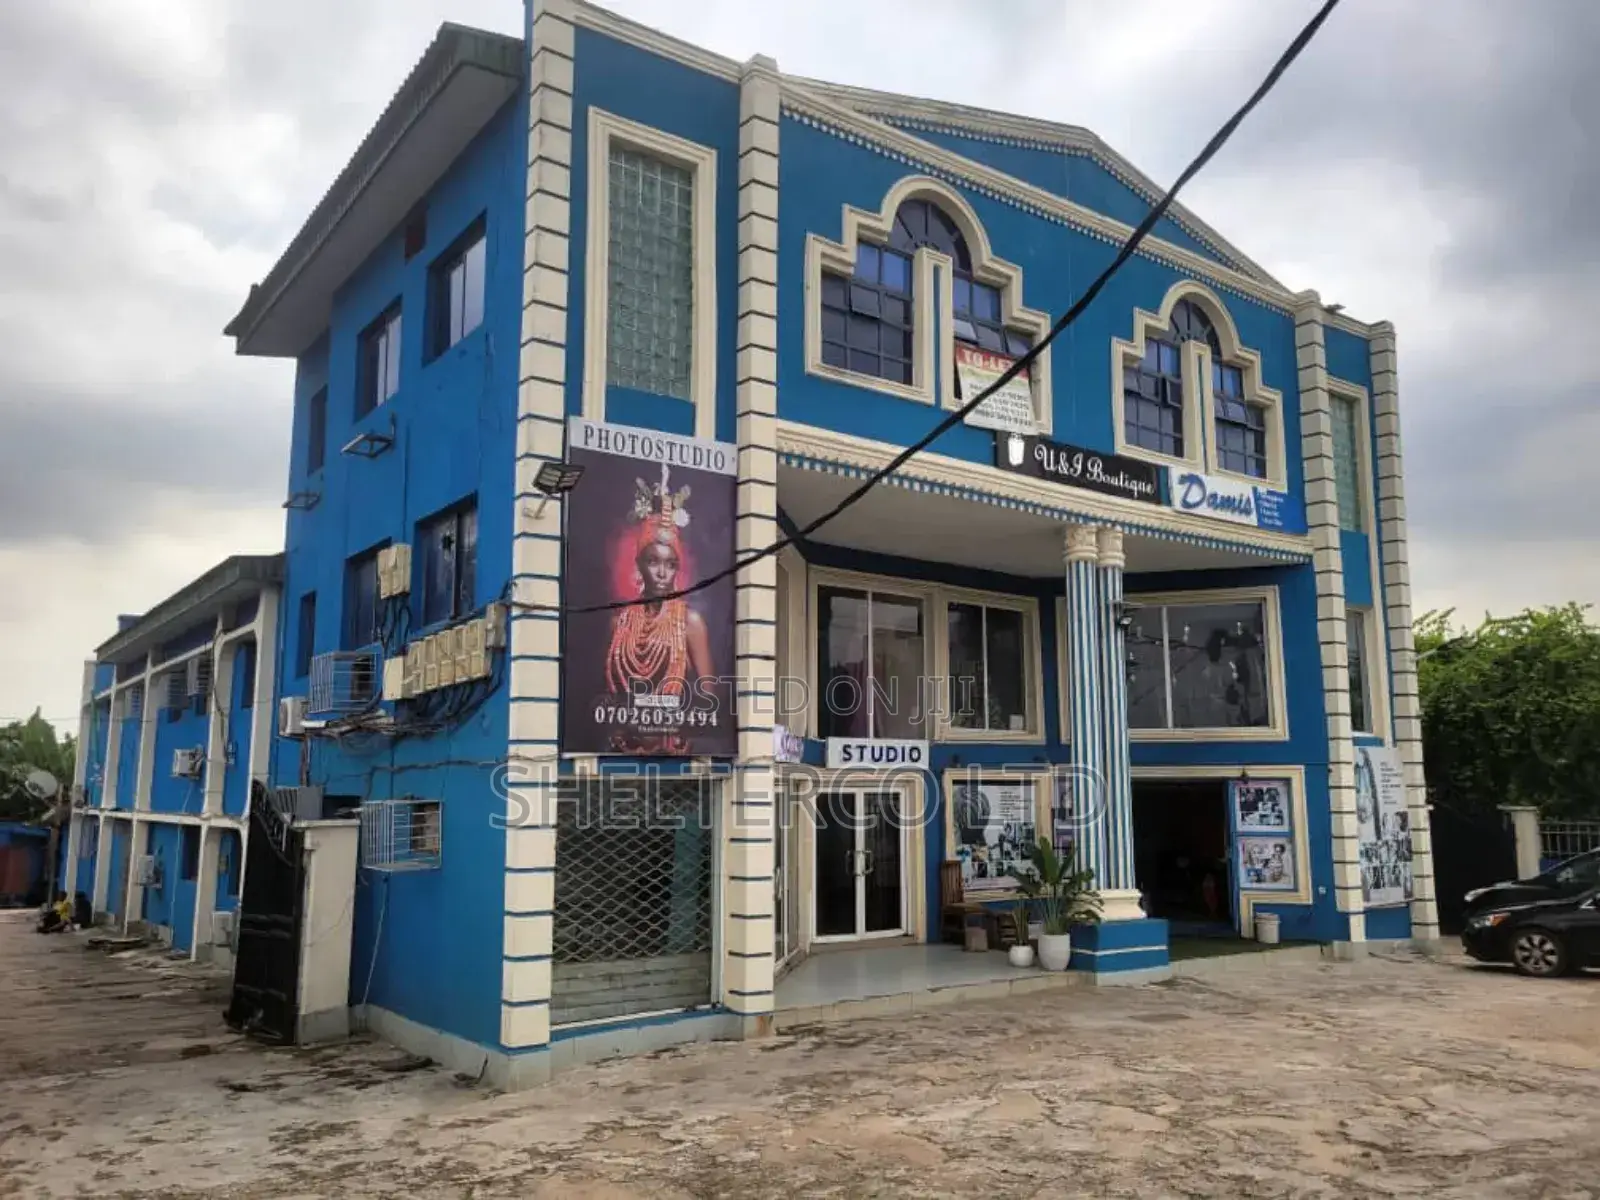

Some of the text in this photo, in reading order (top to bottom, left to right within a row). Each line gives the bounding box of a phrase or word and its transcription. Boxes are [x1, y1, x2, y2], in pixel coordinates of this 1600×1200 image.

[583, 425, 726, 471] PHOTOSTUDIO
[1086, 456, 1155, 499] Boutique
[1178, 473, 1253, 516] Damis
[842, 744, 923, 763] STUDIO
